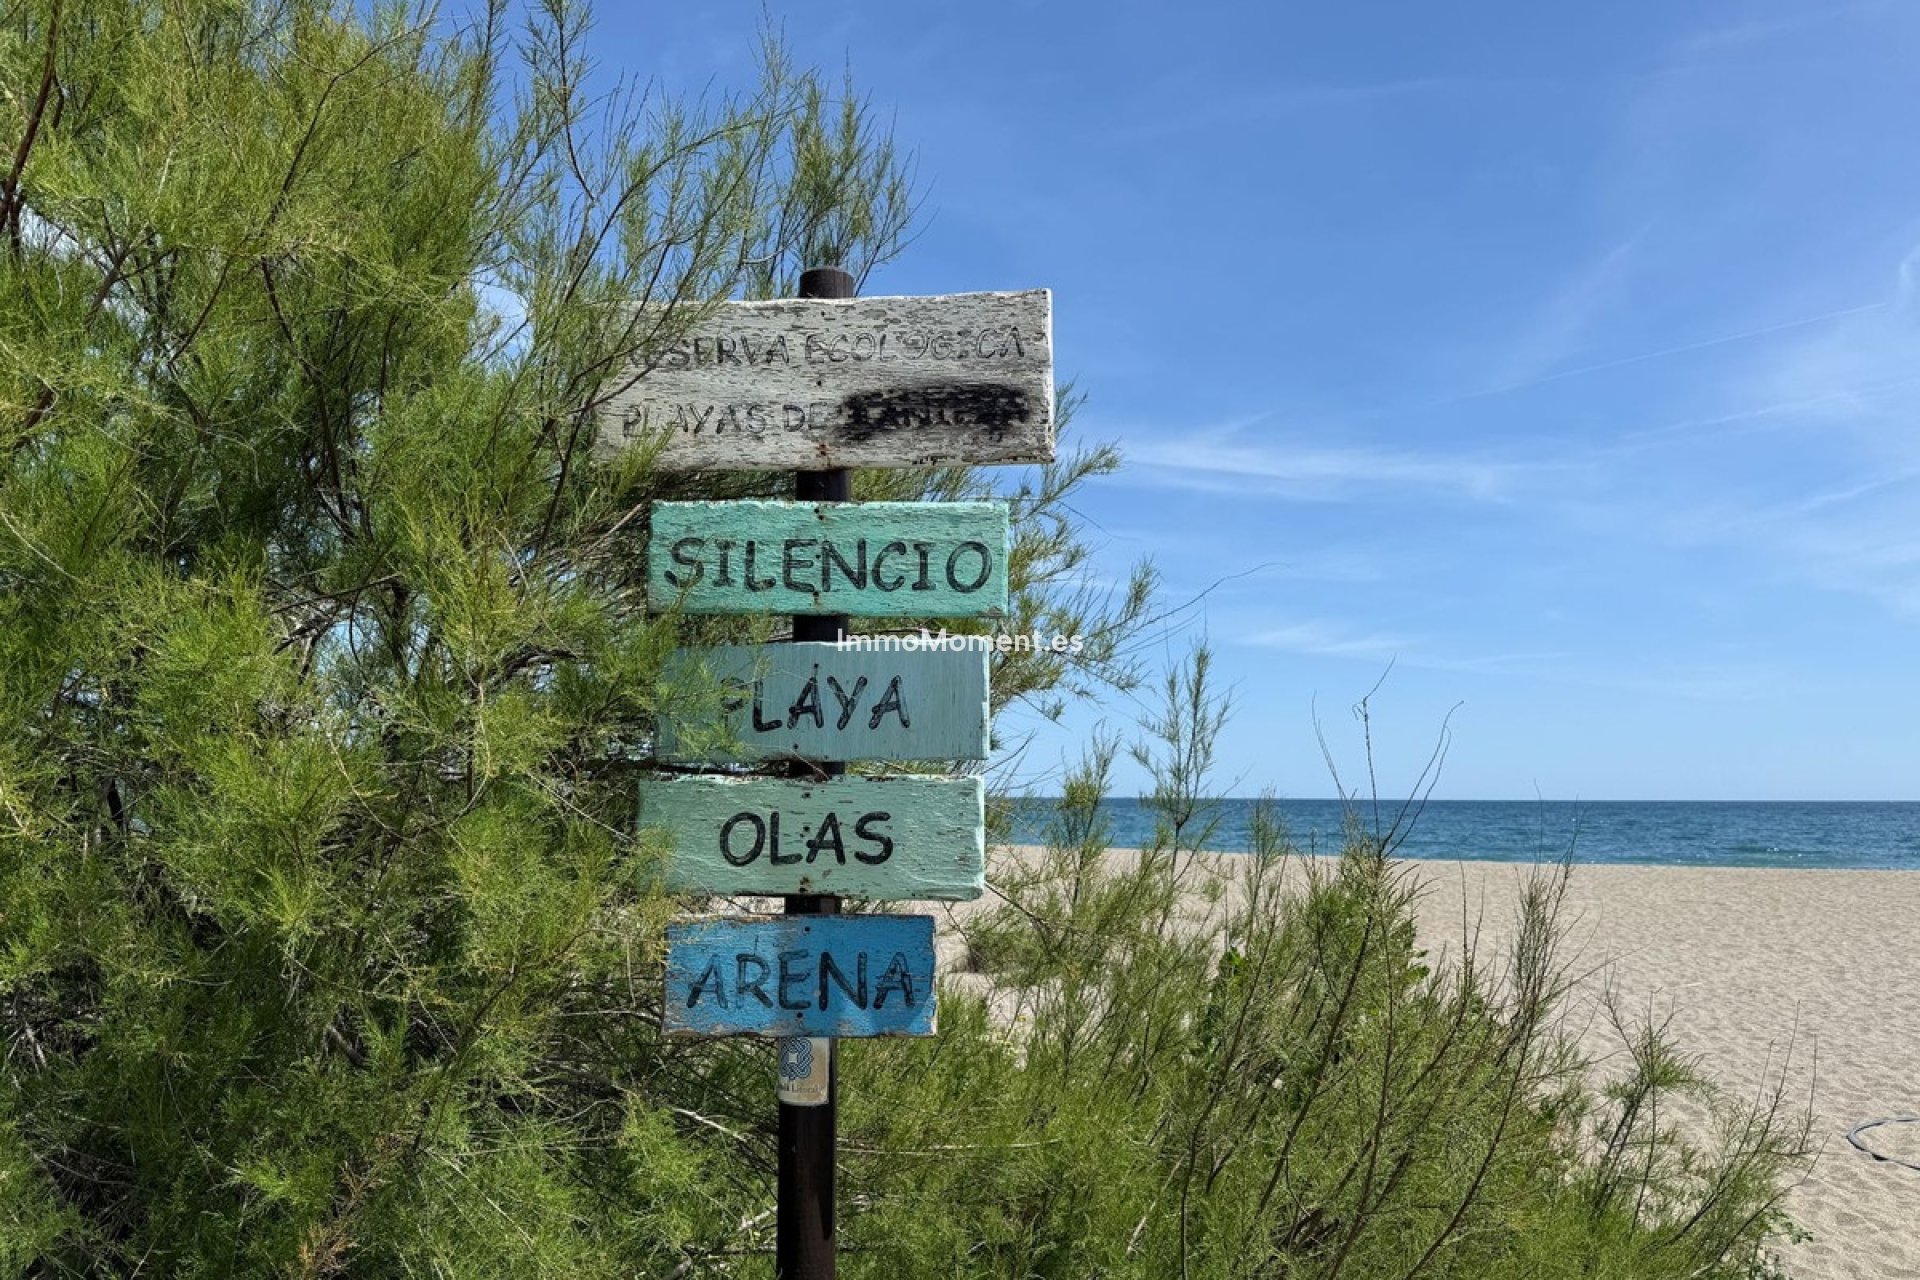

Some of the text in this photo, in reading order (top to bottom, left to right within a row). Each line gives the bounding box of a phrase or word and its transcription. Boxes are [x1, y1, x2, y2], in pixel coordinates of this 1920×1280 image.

[630, 335, 790, 368] SERVA
[783, 402, 828, 432] DE
[663, 536, 993, 593] SILENCIO
[719, 811, 895, 867] OLAS
[685, 951, 916, 1012] ARENA
